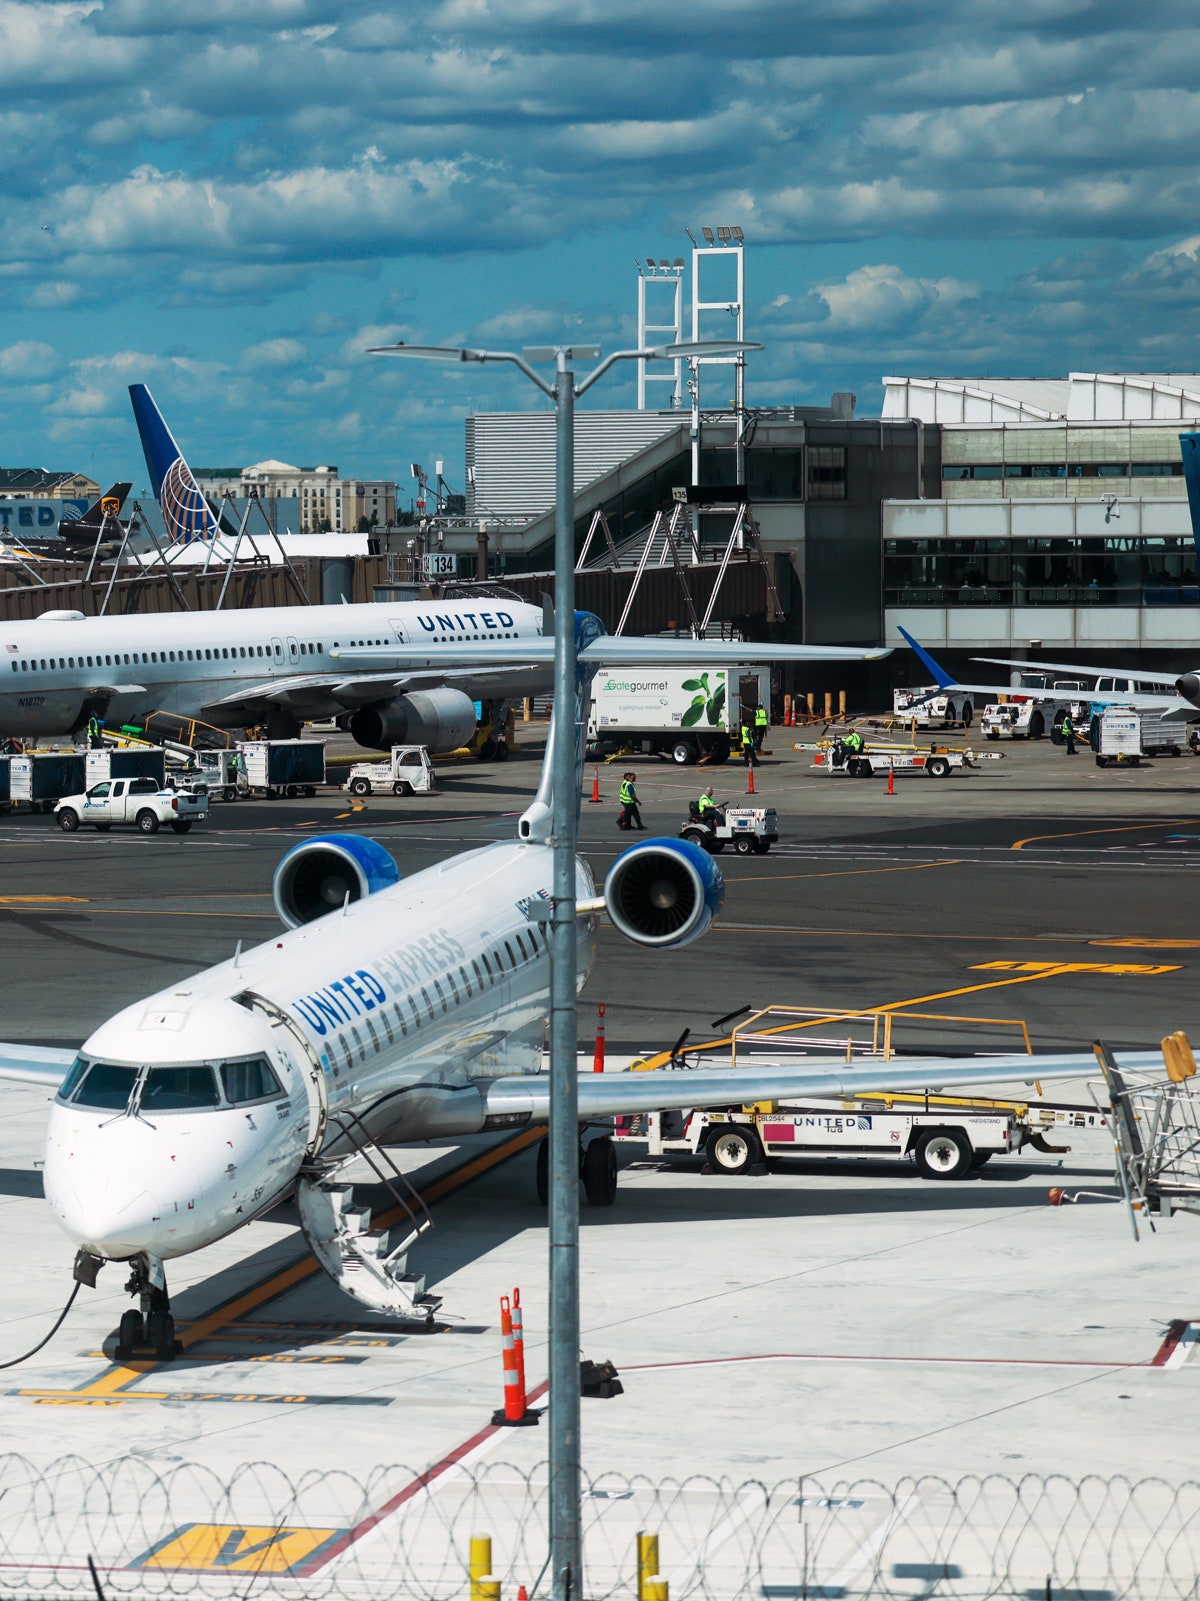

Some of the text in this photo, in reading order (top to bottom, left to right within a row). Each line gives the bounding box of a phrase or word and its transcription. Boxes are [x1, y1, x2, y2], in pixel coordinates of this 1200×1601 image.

[673, 491, 687, 499] 135
[434, 556, 453, 572] 134
[417, 611, 514, 632] UNITED
[603, 679, 668, 693] Gategourmet
[292, 927, 467, 1036] UNITED EXPRESS
[794, 1117, 856, 1127] UNITED
[211, 1529, 297, 1566] V
